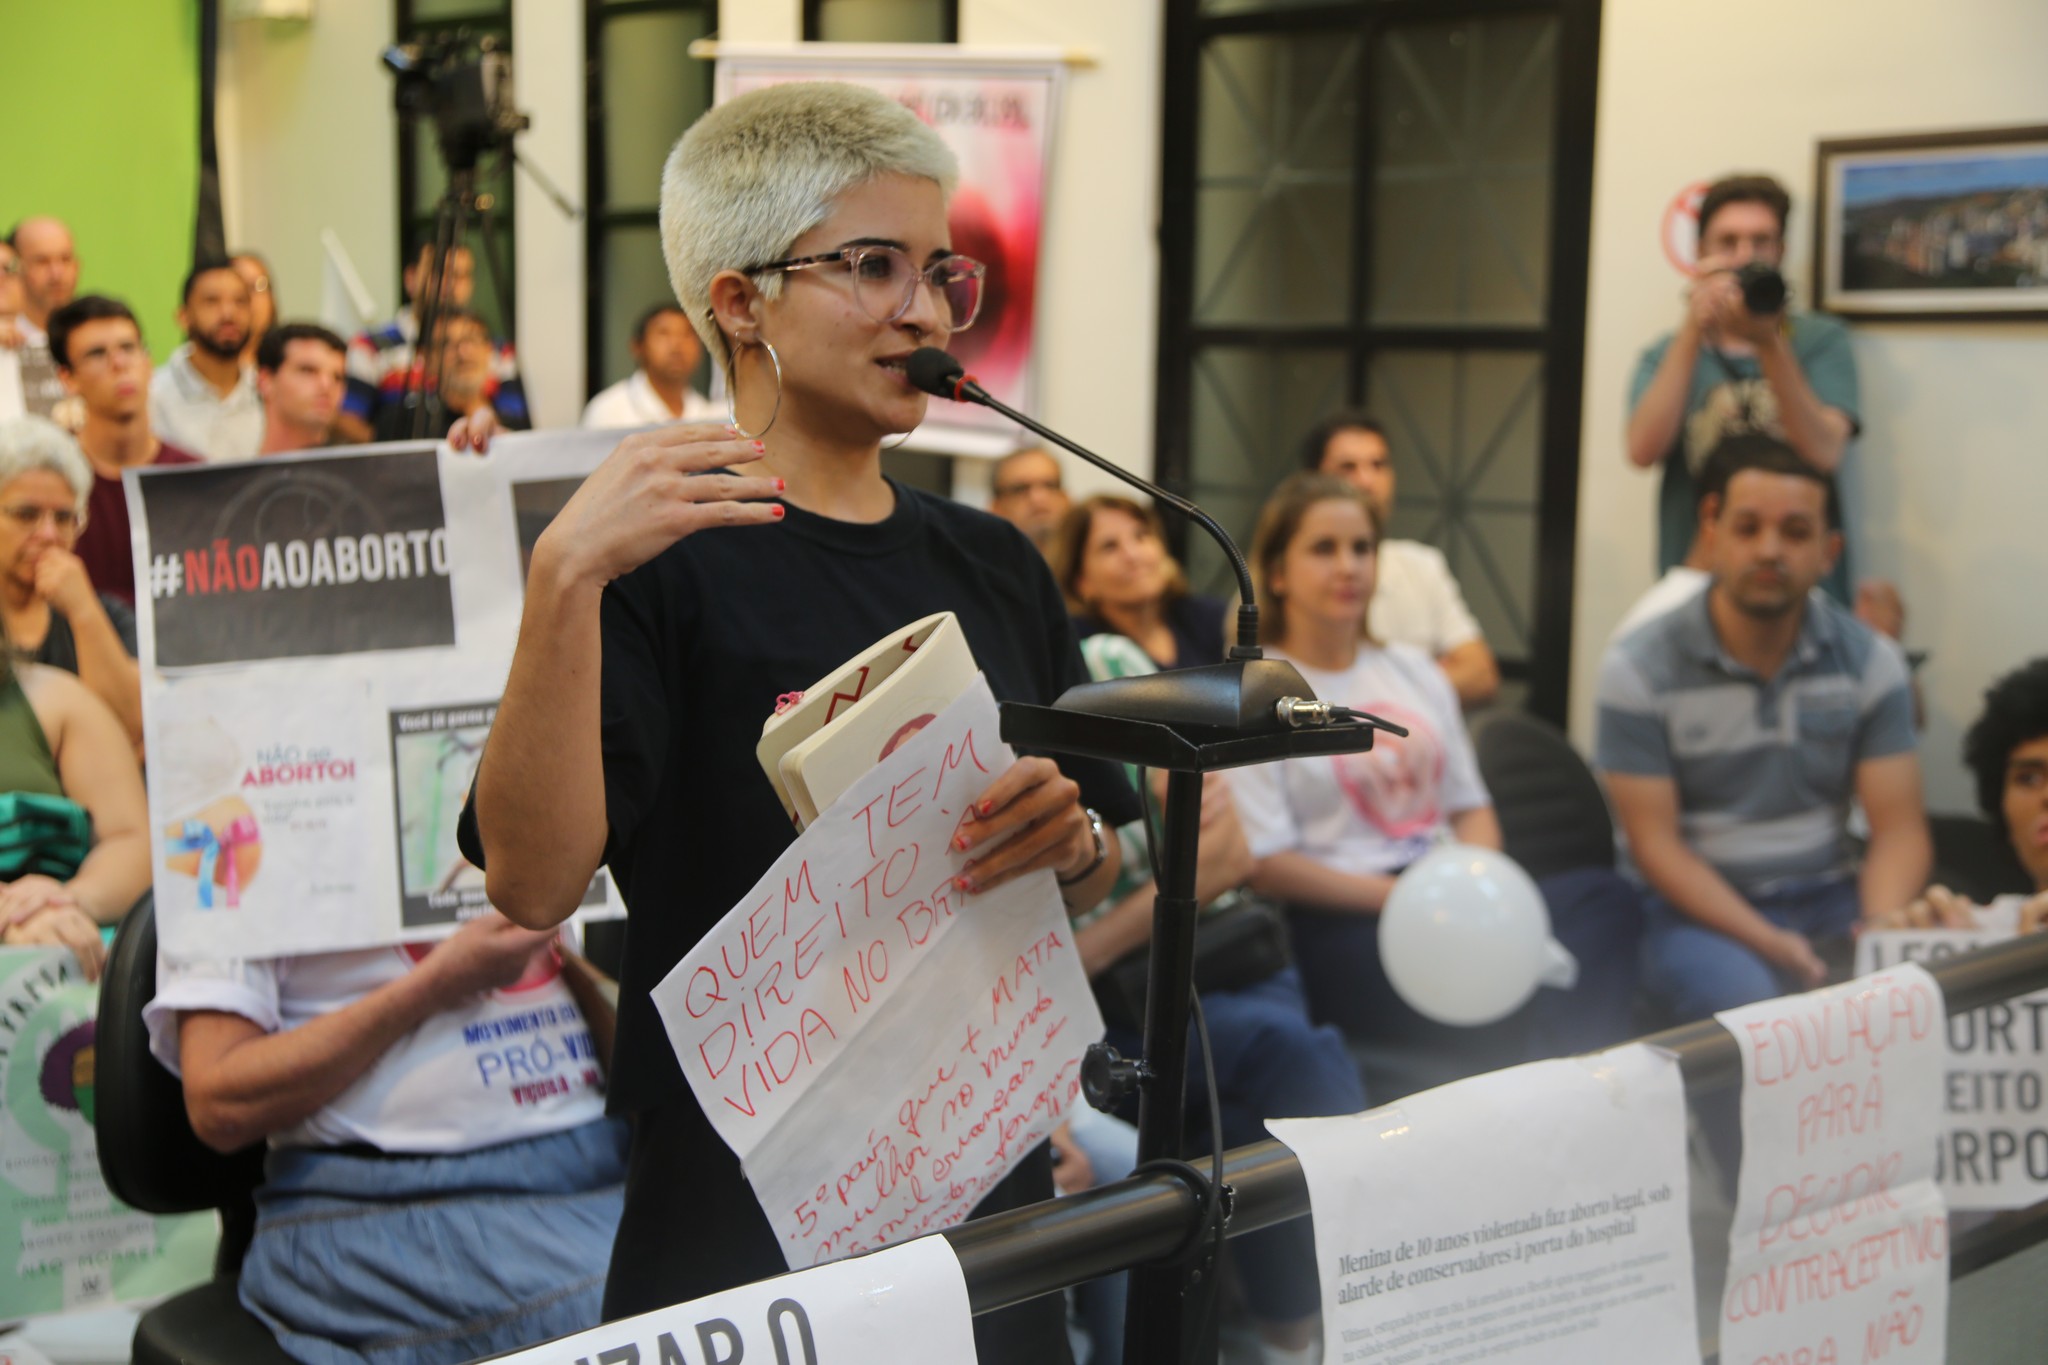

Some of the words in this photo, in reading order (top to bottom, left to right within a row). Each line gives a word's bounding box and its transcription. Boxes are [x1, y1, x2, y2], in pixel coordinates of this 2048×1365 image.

[150, 526, 450, 600] #NÃOAOABORTO
[241, 757, 356, 789] ABORTO!
[686, 859, 820, 1018] QUEM
[852, 728, 989, 858] TEM
[699, 842, 919, 1080] DIREITO
[463, 1007, 558, 1047] MOVIMENTO
[724, 1008, 836, 1117] VIDA
[843, 939, 888, 1014] NO
[837, 1128, 890, 1206] país
[899, 1060, 958, 1138] que
[993, 931, 1064, 1025] MATA
[942, 1082, 974, 1133] no
[1338, 1275, 1384, 1305] alarde
[1386, 1270, 1404, 1292] de
[1407, 1247, 1511, 1286] conservadores
[1524, 1235, 1563, 1264] porta
[1566, 1228, 1584, 1249] do
[1586, 1215, 1636, 1245] hospital
[1339, 1248, 1392, 1277] Menina
[1395, 1240, 1414, 1262] de
[1417, 1237, 1432, 1258] 10
[1435, 1231, 1469, 1253] anos
[1473, 1210, 1542, 1246] violentada
[1545, 1207, 1565, 1228] faz
[1568, 1200, 1609, 1223] aborto
